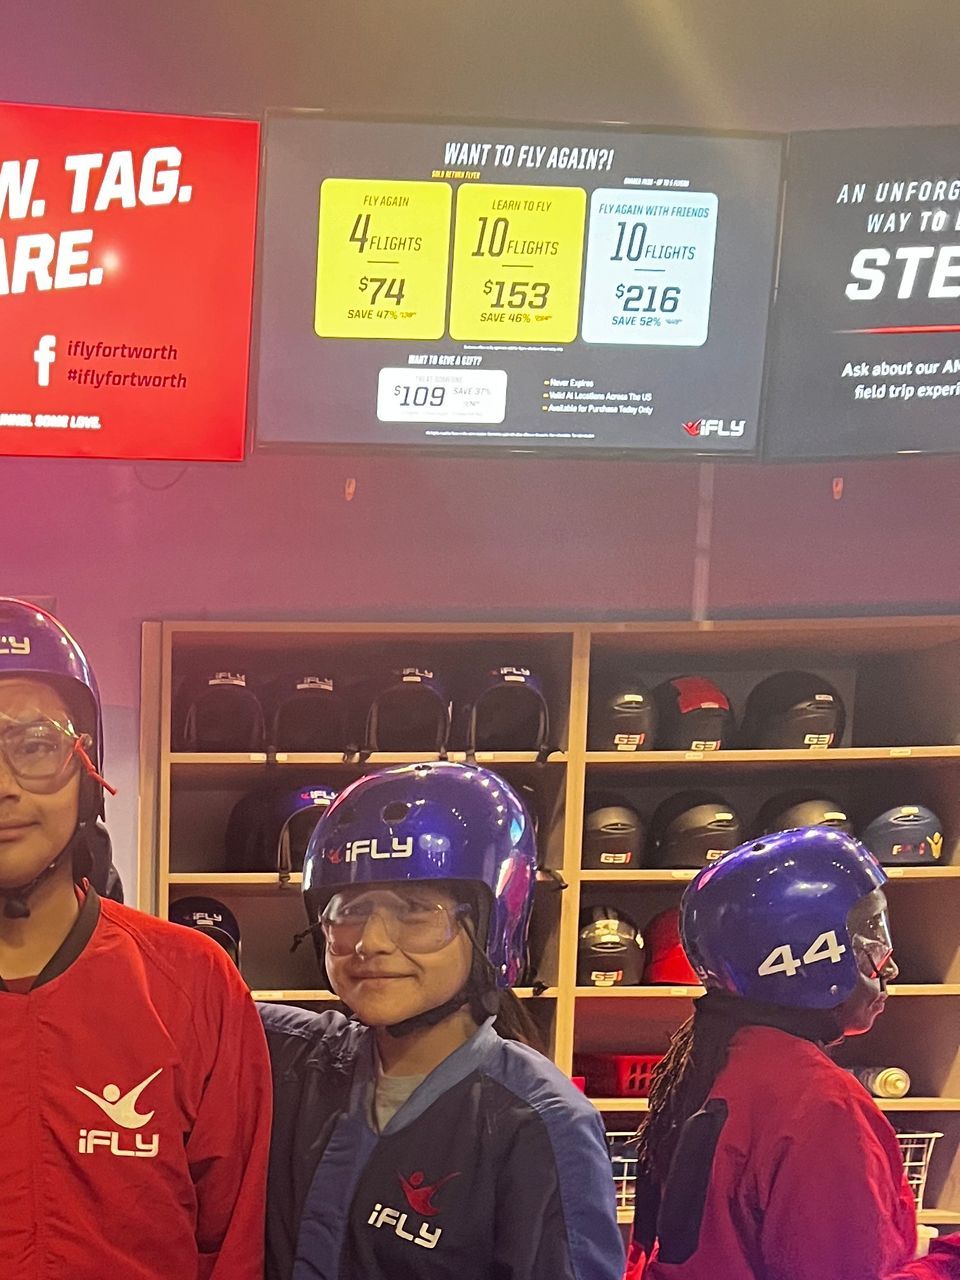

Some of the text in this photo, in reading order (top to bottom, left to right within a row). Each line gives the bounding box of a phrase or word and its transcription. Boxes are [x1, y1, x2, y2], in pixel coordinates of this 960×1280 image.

[444, 142, 615, 171] WANT TO FLY AGAIN?!
[64, 145, 193, 213] TAG.
[364, 195, 409, 207] FLY AGAIN
[836, 183, 866, 204] AN
[492, 199, 552, 212] LEARN TO FLY
[599, 203, 710, 218] FLY AGAIN WITH FRIENDS
[867, 211, 912, 233] WAY
[920, 210, 947, 232] TO
[349, 213, 422, 254] 4 FLIGHTS
[472, 216, 559, 257] 10 FLIGHTS
[610, 221, 696, 262] 10 FLIGHTS
[845, 246, 960, 300] STE
[358, 276, 406, 306] $74
[483, 279, 551, 310] $153
[615, 283, 681, 313] $216
[347, 309, 372, 319] SAVE
[376, 310, 398, 320] 47%
[480, 312, 505, 322] SAVE
[509, 313, 531, 323] 46%
[612, 316, 637, 326] SAVE
[640, 316, 661, 326] 52%
[67, 340, 178, 361] iflyfortworth
[67, 369, 187, 389] #iflyfortworth
[841, 361, 870, 378] Ask
[872, 361, 913, 376] about
[915, 362, 940, 375] our
[394, 384, 446, 407] $109
[854, 383, 886, 400] field
[889, 384, 915, 401] trip
[757, 930, 846, 977] 44
[78, 1129, 159, 1158] iFLY
[367, 1203, 442, 1249] iFLY
